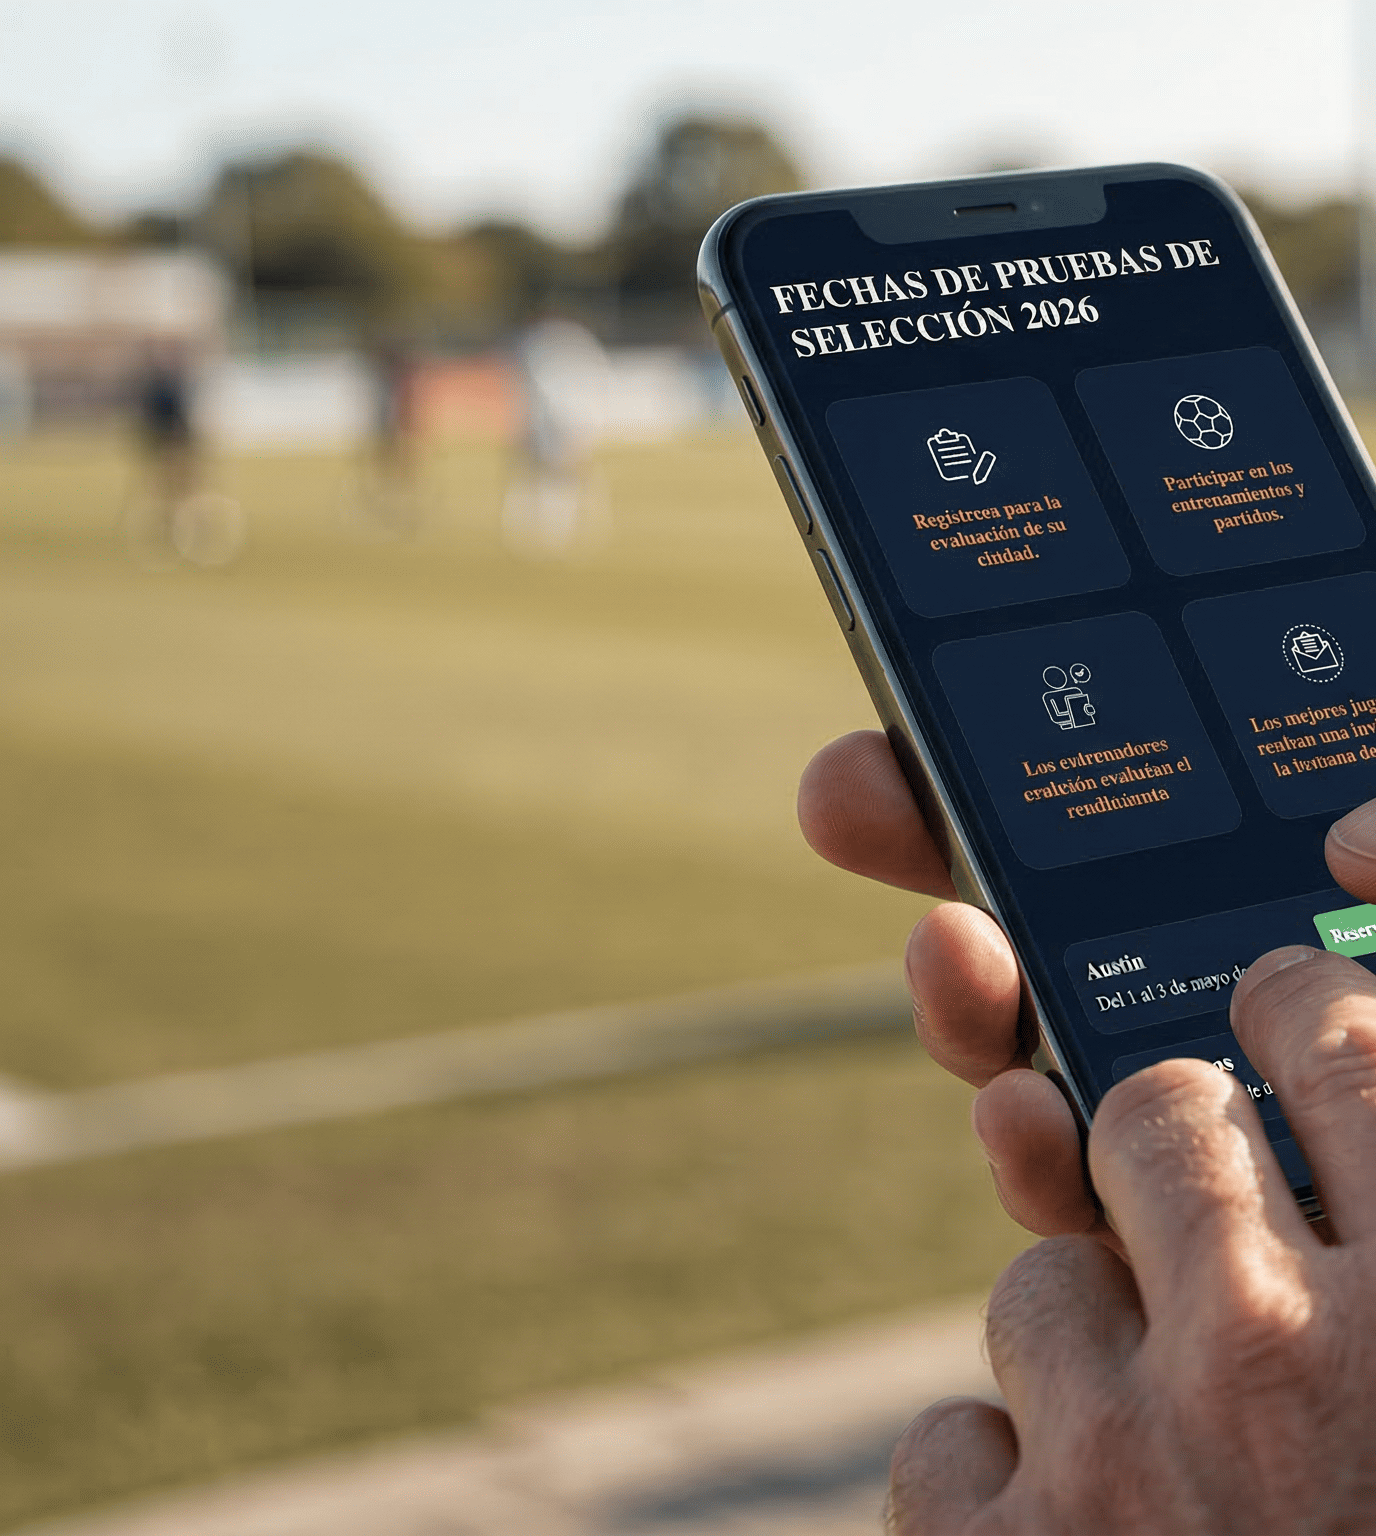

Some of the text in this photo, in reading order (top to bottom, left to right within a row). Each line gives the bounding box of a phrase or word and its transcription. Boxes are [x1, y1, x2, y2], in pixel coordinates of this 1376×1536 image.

[770, 239, 1220, 314] FECHAS DE PRUEBAS DE
[790, 295, 1099, 358] SELECCIÓN 2026
[1163, 461, 1293, 492] Participar en los
[1003, 502, 1043, 520] para
[1043, 495, 1062, 510] la
[1171, 483, 1304, 513] entrenamientos y
[930, 520, 1067, 551] evaluación de su
[1213, 509, 1284, 534] partidos.
[1249, 717, 1282, 733] Los
[1284, 704, 1348, 726] mejores
[1318, 728, 1350, 744] una
[1022, 760, 1057, 778] Los
[1176, 756, 1192, 772] el
[1273, 761, 1292, 778] la
[1087, 954, 1148, 981] Austin
[1095, 993, 1126, 1012] Del
[1127, 989, 1138, 1005] 1
[1140, 984, 1156, 1003] al
[1156, 983, 1167, 999] 3
[1169, 979, 1188, 996] de
[1190, 972, 1230, 991] mayo
